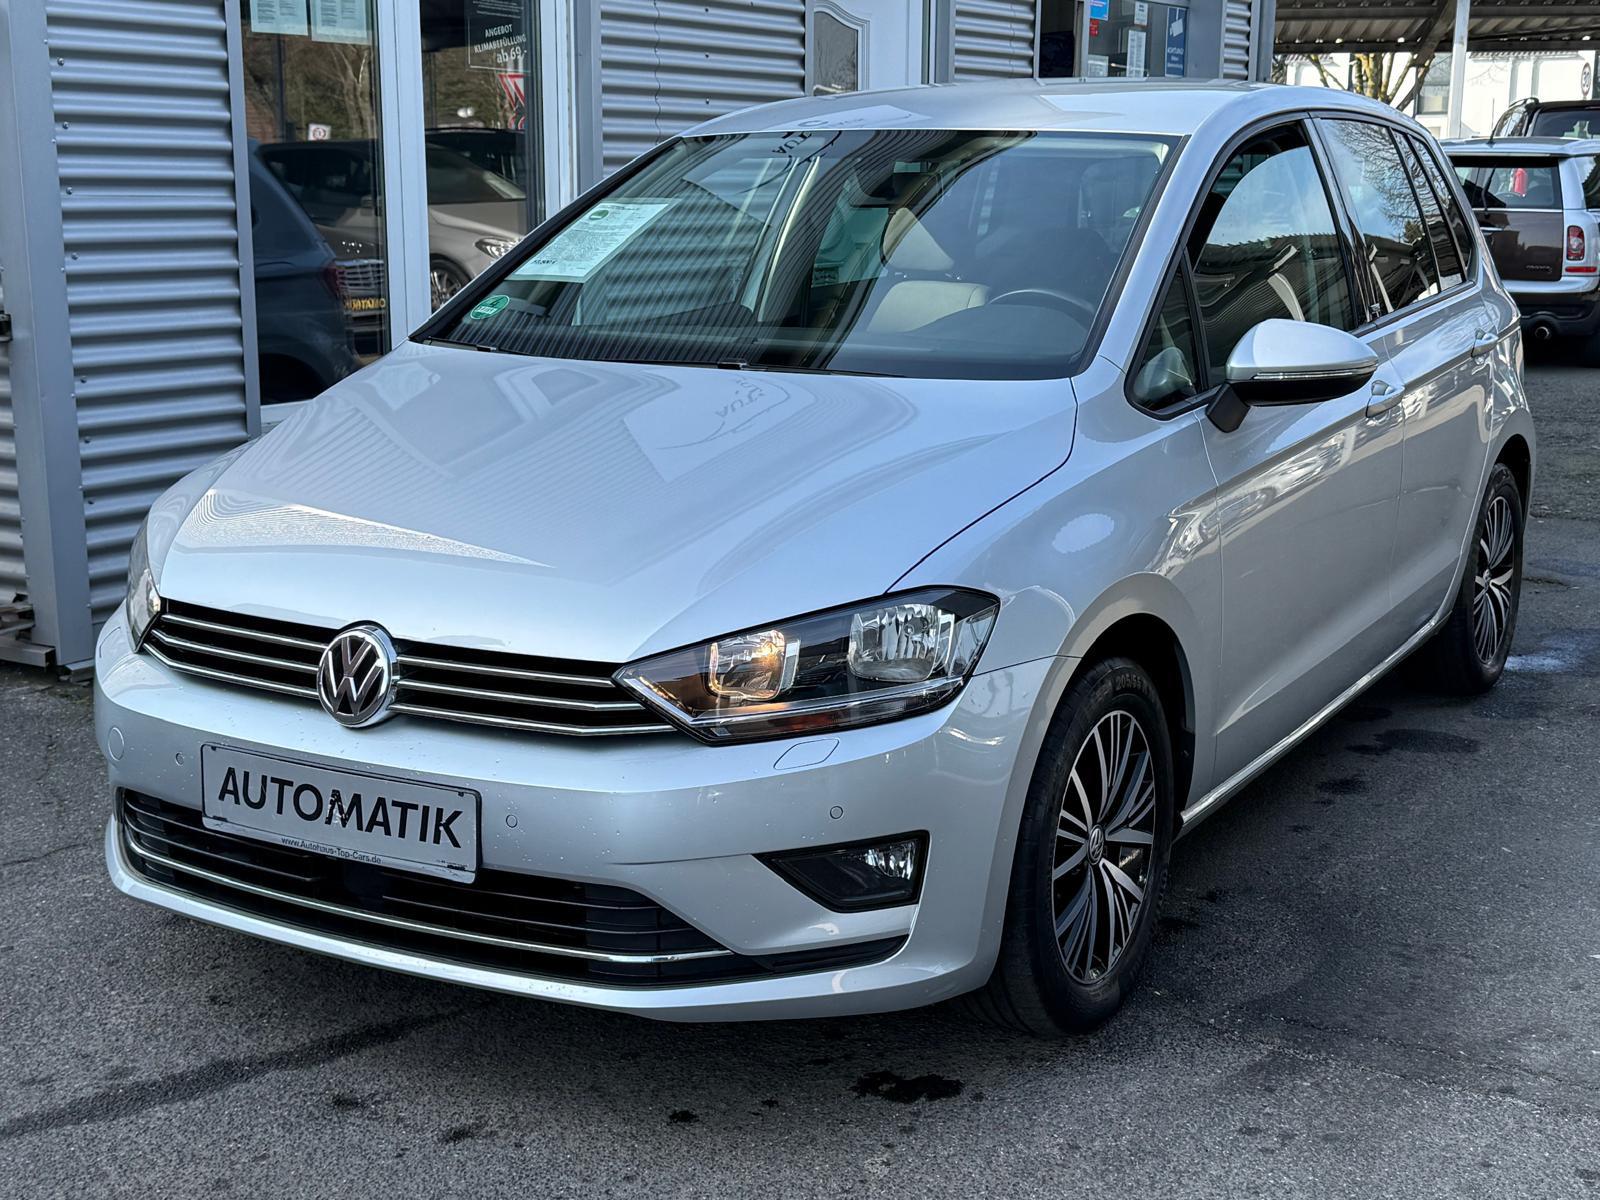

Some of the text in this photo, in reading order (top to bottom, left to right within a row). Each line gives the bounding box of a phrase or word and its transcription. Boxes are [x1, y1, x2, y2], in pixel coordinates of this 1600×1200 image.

[485, 24, 513, 38] ANGEBOT
[497, 49, 509, 63] ab
[218, 766, 463, 849] AUTOMATIK
[281, 837, 382, 864] www.Autohaus-Top-Cars.de
